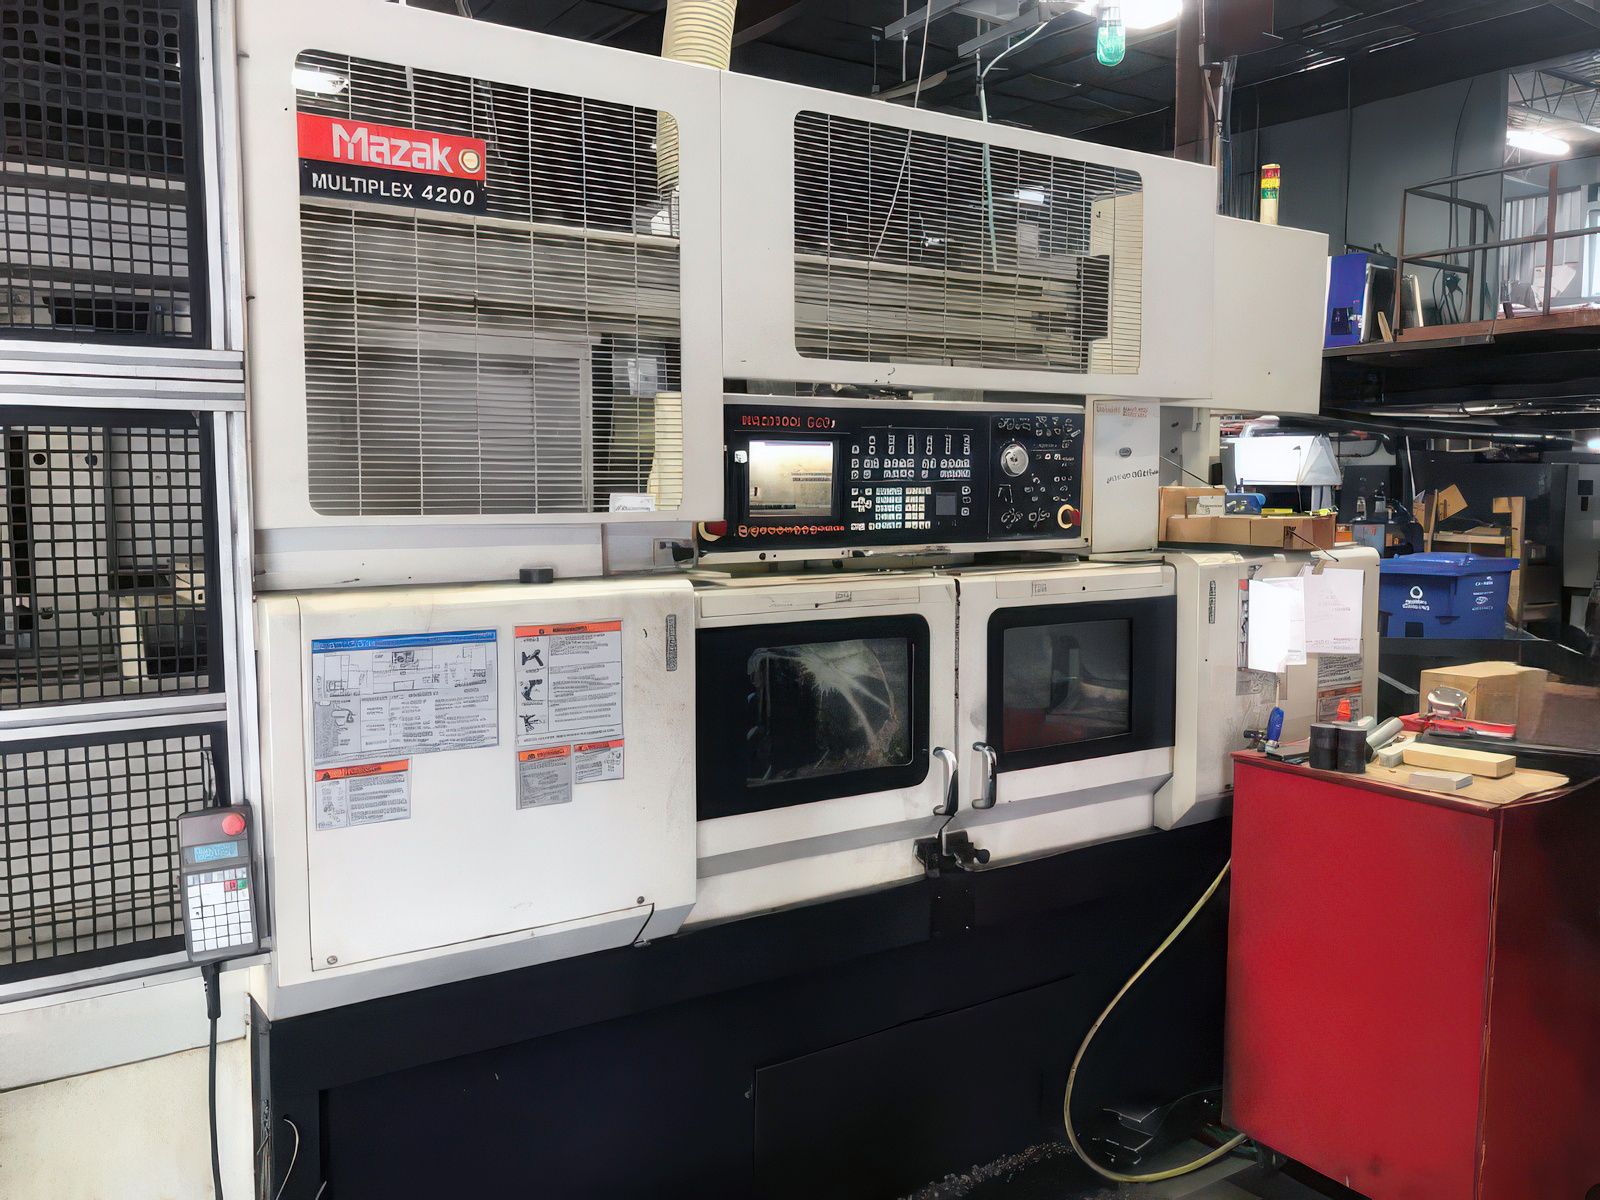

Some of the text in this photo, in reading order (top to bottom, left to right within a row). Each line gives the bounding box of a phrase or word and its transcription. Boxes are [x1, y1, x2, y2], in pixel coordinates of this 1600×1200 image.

[331, 123, 454, 174] Mazak
[311, 172, 475, 206] MULTIPLEX 4200
